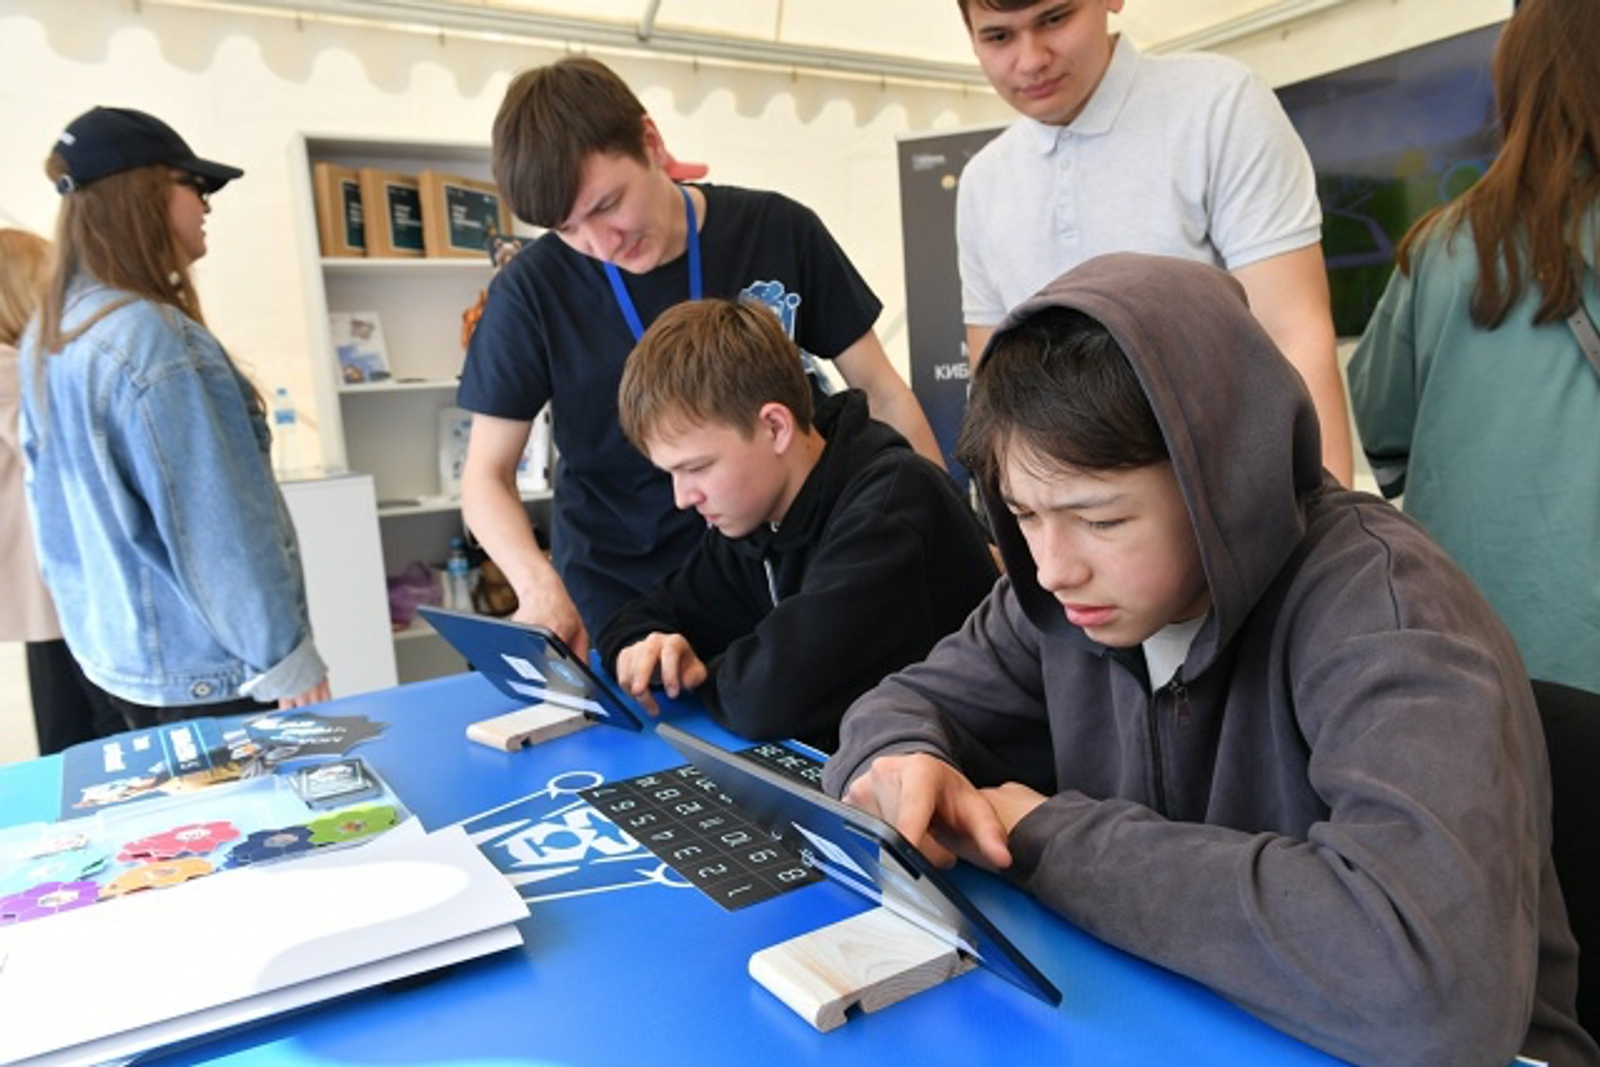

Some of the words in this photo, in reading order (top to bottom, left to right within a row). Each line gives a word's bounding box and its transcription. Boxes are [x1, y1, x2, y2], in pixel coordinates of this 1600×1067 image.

[934, 363, 970, 380] КИБ
[592, 788, 617, 798] 7
[611, 800, 635, 812] 6
[675, 801, 703, 815] 12
[630, 814, 656, 827] 5
[651, 829, 675, 840] 4
[721, 831, 752, 847] 10
[674, 846, 702, 860] 3
[749, 849, 777, 862] 9
[698, 863, 728, 878] 2
[778, 868, 807, 882] 8
[728, 884, 752, 898] 1
